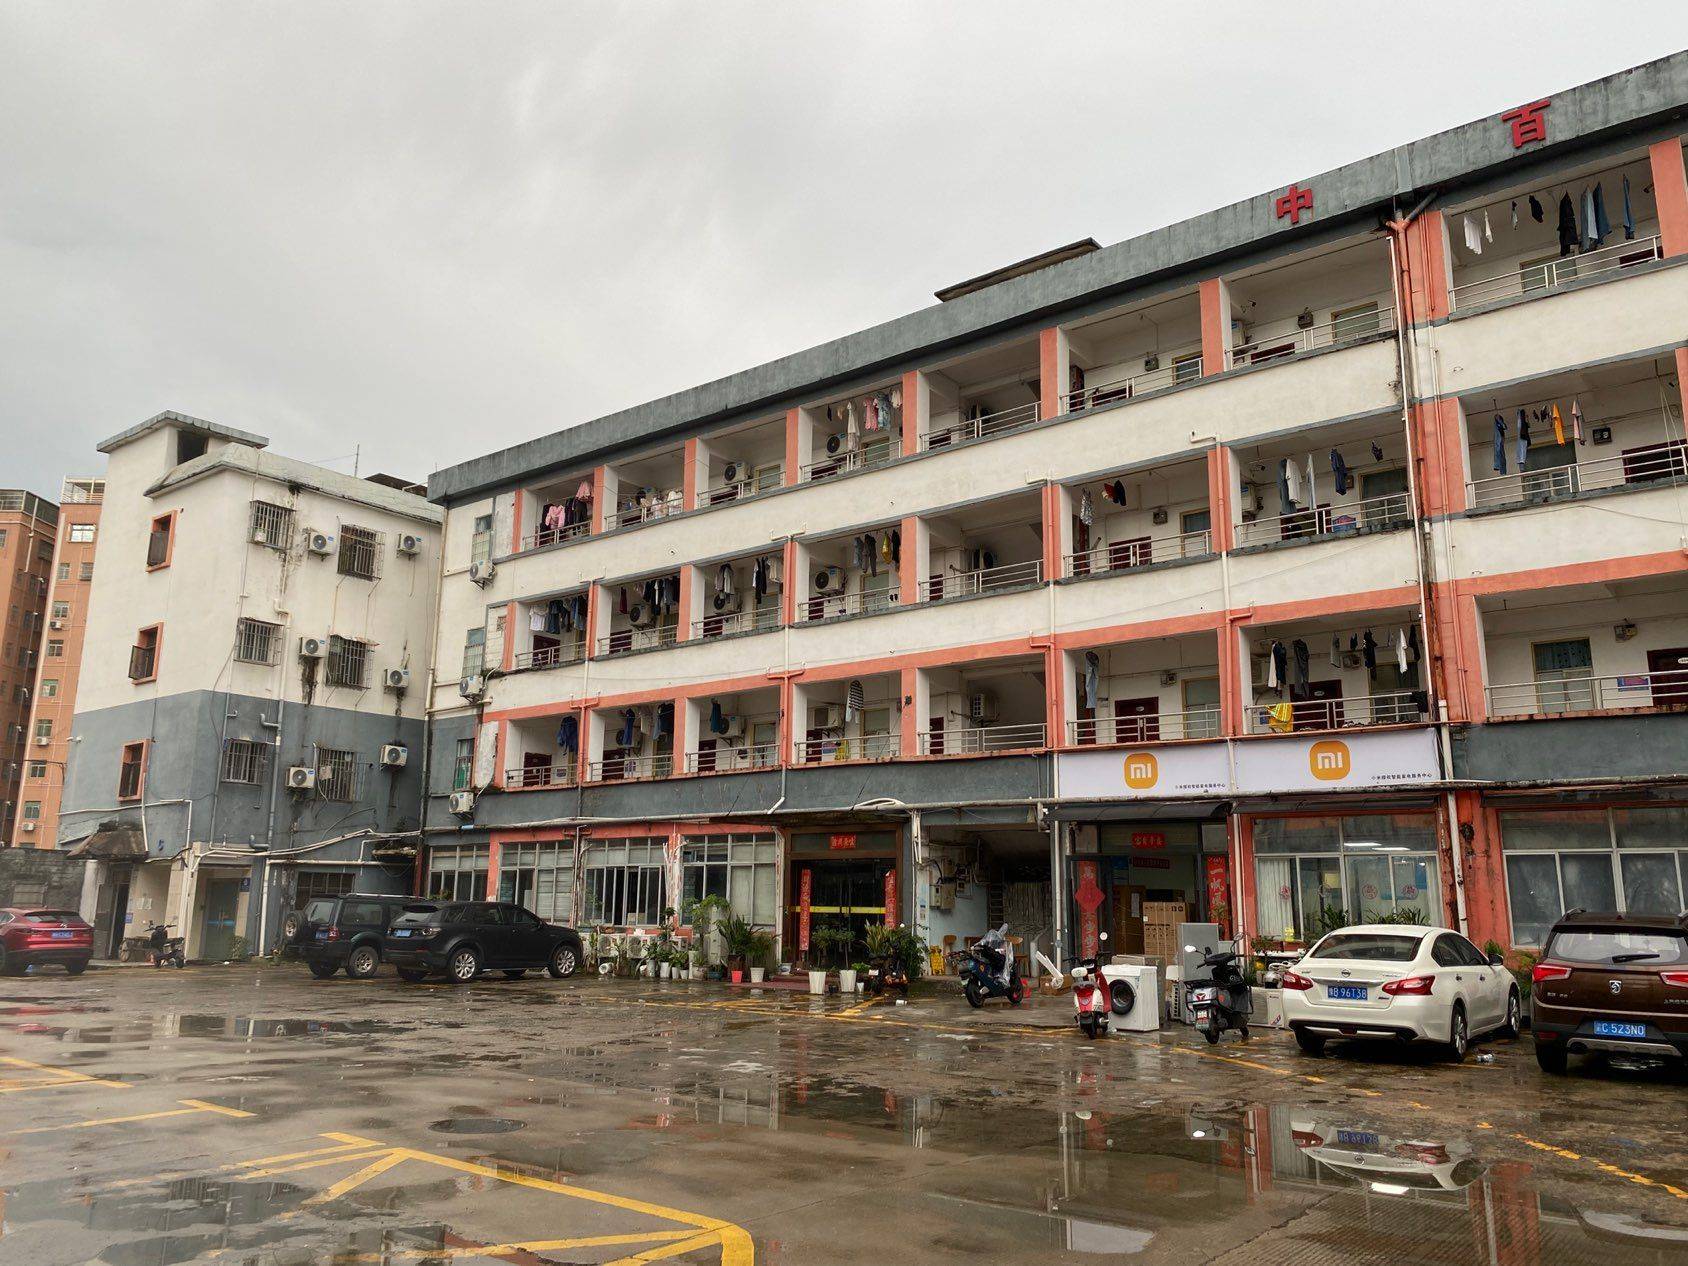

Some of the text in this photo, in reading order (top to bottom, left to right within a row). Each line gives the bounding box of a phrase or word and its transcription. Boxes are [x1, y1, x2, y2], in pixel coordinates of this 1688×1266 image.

[1276, 99, 1551, 224] 中 百
[1594, 1021, 1645, 1037] C523N0
